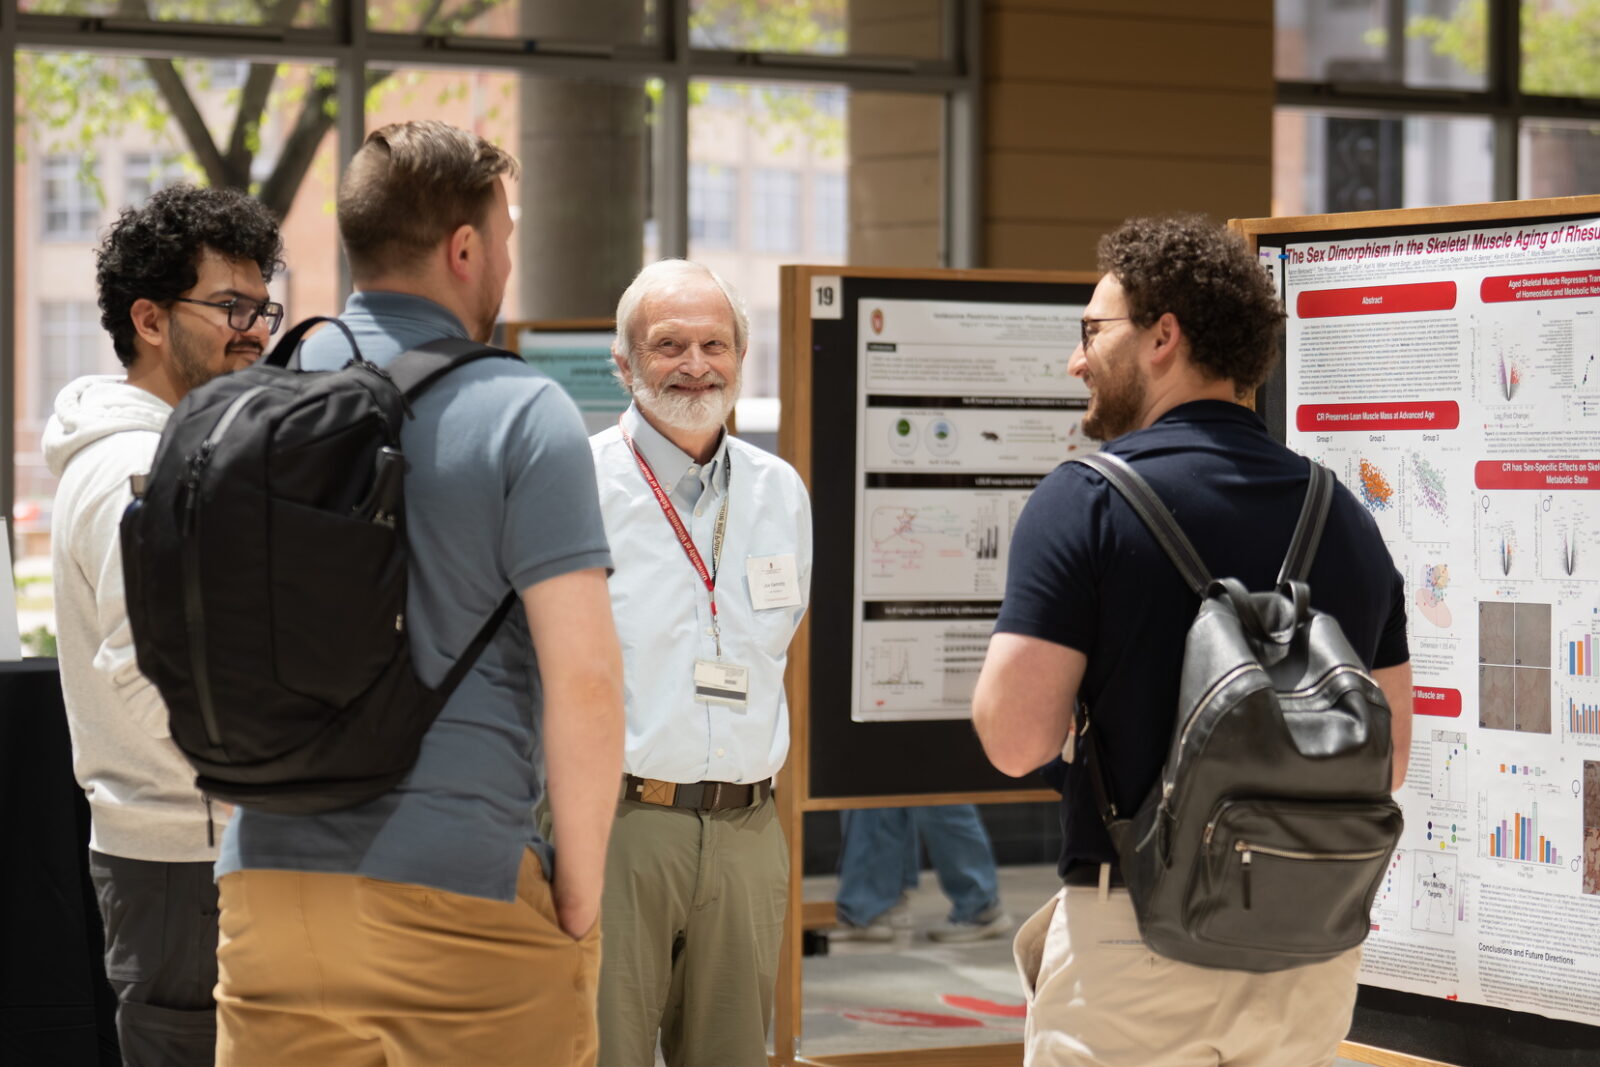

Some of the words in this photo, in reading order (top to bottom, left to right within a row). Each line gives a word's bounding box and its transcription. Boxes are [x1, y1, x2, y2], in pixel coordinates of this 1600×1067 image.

[1286, 248, 1304, 265] The
[1306, 246, 1325, 264] Sex
[1327, 243, 1391, 263] Dimorphism
[1393, 240, 1404, 257] in
[1406, 239, 1424, 255] the
[1426, 234, 1470, 254] Skeletal
[1472, 231, 1512, 250] Muscle
[1514, 229, 1549, 251] Aging
[1551, 227, 1564, 244] of
[1508, 280, 1522, 290] Aged
[1522, 278, 1542, 287] Skeletal
[1542, 277, 1560, 286] Muscle
[1561, 276, 1588, 286] Represses
[816, 286, 834, 306] 19
[1522, 289, 1552, 298] Homeostatic
[1553, 288, 1563, 296] and
[1564, 287, 1589, 296] Metabolic
[1361, 296, 1383, 305] Abstract
[1316, 413, 1325, 421] CR
[1325, 412, 1350, 421] Preserves
[1350, 412, 1362, 421] Lean
[1362, 411, 1379, 420] Muscle
[1380, 411, 1393, 420] Mass
[1393, 411, 1399, 419] at
[1399, 410, 1424, 419] Advanced
[1424, 410, 1435, 421] Age
[1316, 435, 1330, 443] Group
[1369, 434, 1382, 442] Group
[1422, 434, 1436, 442] Group
[1502, 463, 1511, 472] CR
[1512, 463, 1522, 471] has
[1523, 463, 1557, 473] Sex-Specific
[1558, 463, 1578, 471] Effects
[1546, 475, 1573, 484] Metabolic
[1574, 475, 1588, 484] State
[654, 487, 670, 510] School
[667, 509, 687, 542] Wisconsin
[688, 548, 708, 580] University
[1417, 689, 1436, 700] Muscle
[1478, 942, 1513, 956] Conclusions
[1513, 948, 1524, 957] and
[1525, 949, 1544, 960] Future
[1544, 952, 1576, 966] Directions:
